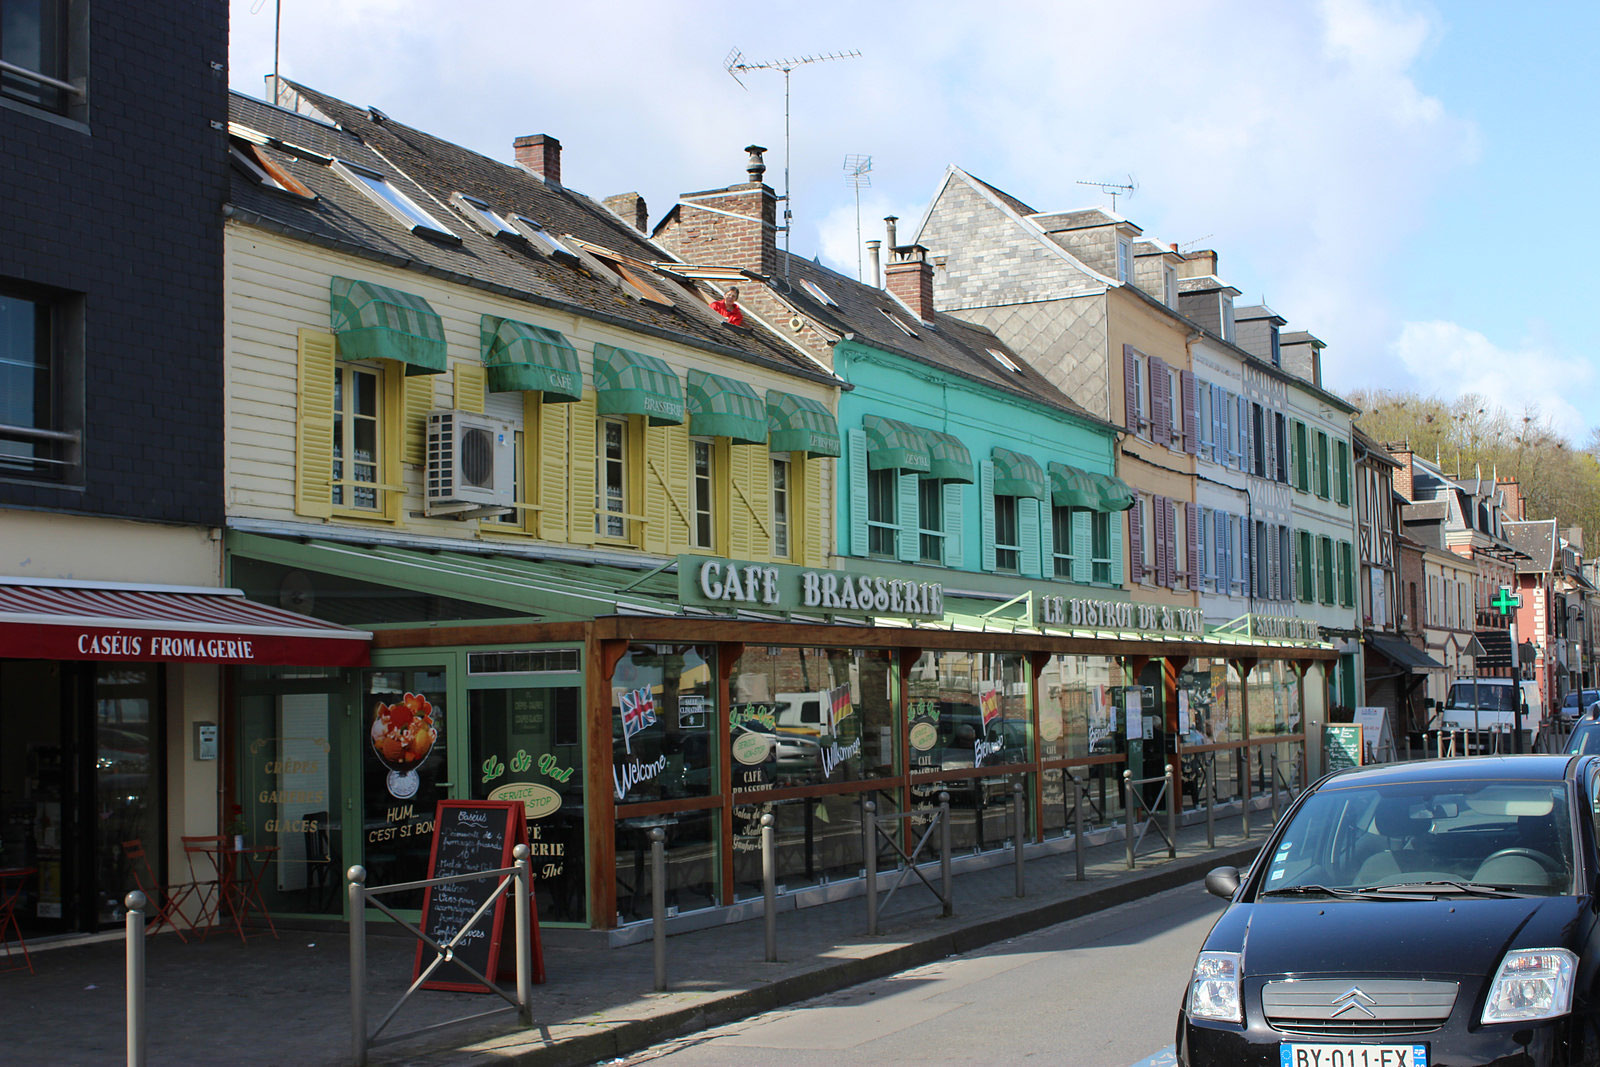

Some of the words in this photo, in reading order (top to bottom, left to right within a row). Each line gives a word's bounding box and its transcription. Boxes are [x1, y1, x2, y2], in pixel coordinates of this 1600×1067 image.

[550, 374, 573, 390] CAFÉ
[644, 397, 682, 416] BRASSERIE
[700, 559, 780, 604] CAFE
[801, 571, 944, 615] BRASSERIE
[1043, 595, 1065, 623] LE
[1070, 598, 1134, 627] BISTROT
[1138, 604, 1157, 630] DE
[77, 630, 142, 656] CASÉUS
[264, 757, 319, 774] CRÊPES
[482, 754, 505, 783] Le
[510, 749, 532, 772] St
[538, 753, 575, 783] Val
[743, 767, 762, 783] CAFÉ
[612, 754, 666, 800] Welcome
[498, 787, 534, 801] SERVICE
[264, 819, 318, 833] GLACES
[368, 828, 398, 843] C'EST
[400, 824, 413, 837] SI
[415, 820, 436, 835] BON
[541, 862, 564, 880] Thé
